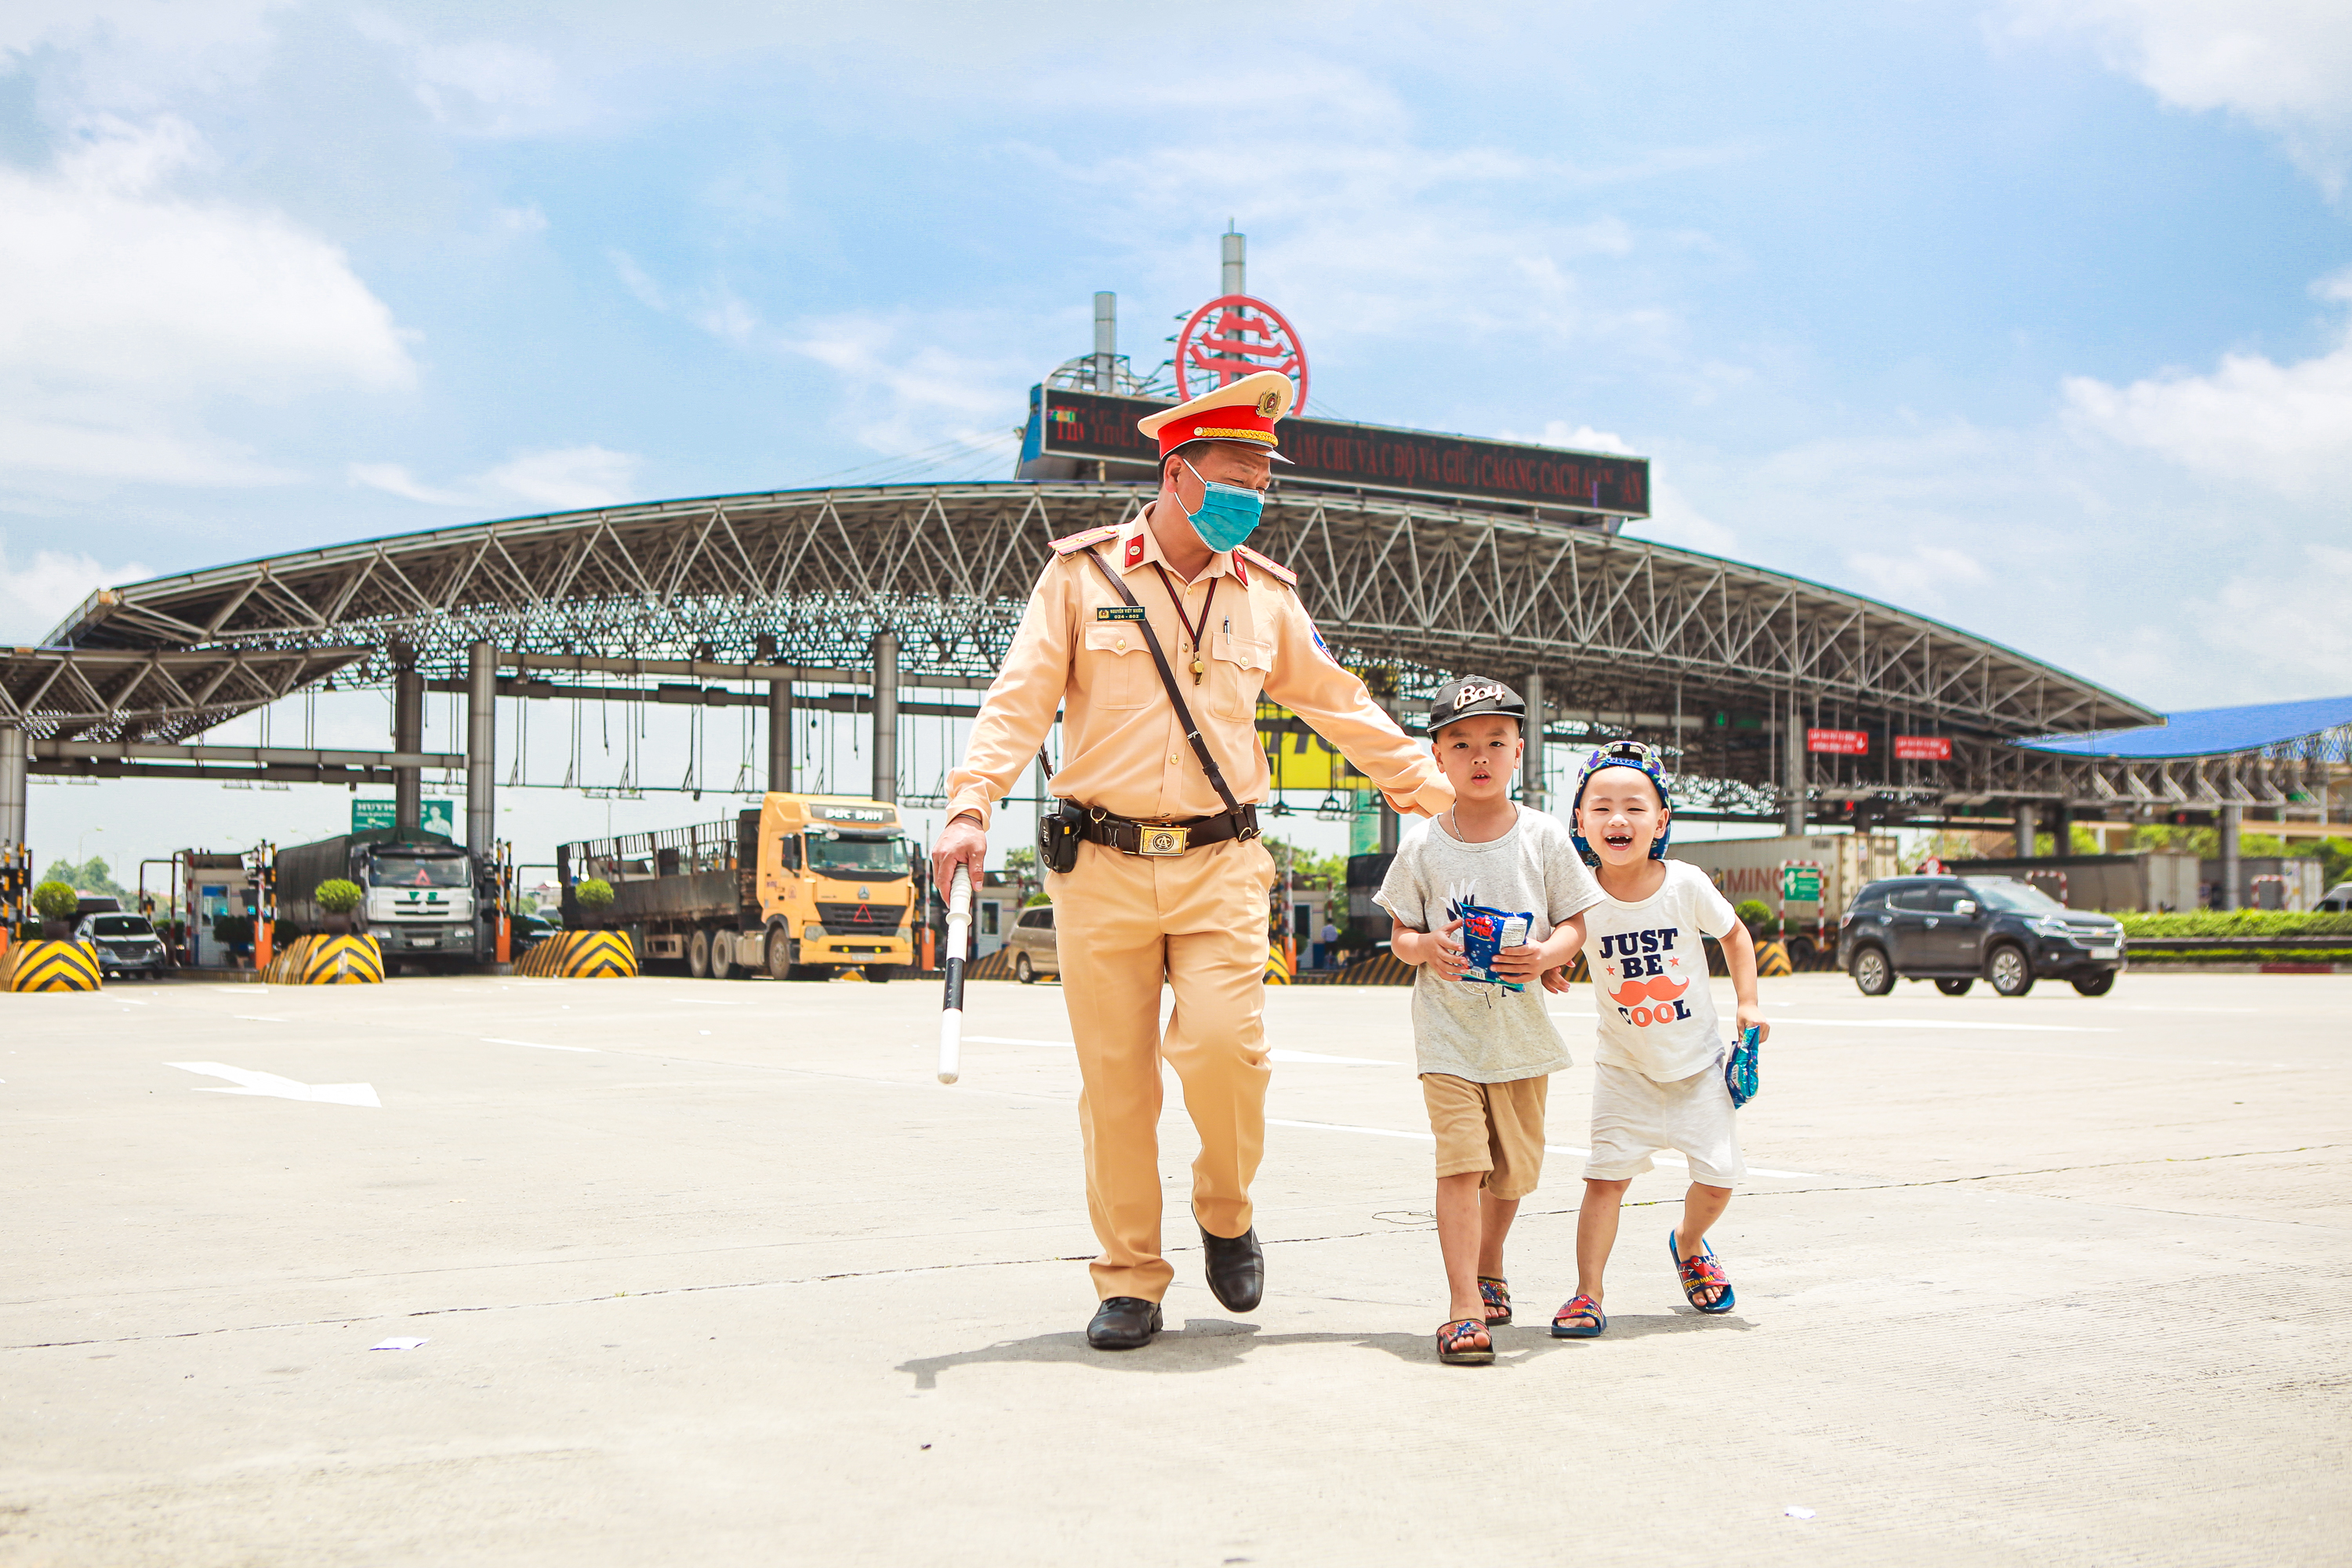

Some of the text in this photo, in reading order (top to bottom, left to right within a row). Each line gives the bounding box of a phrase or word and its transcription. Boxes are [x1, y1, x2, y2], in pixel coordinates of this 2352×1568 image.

[1454, 684, 1505, 710] Boy
[1599, 928, 1678, 959] JUST
[1621, 954, 1663, 978] BE
